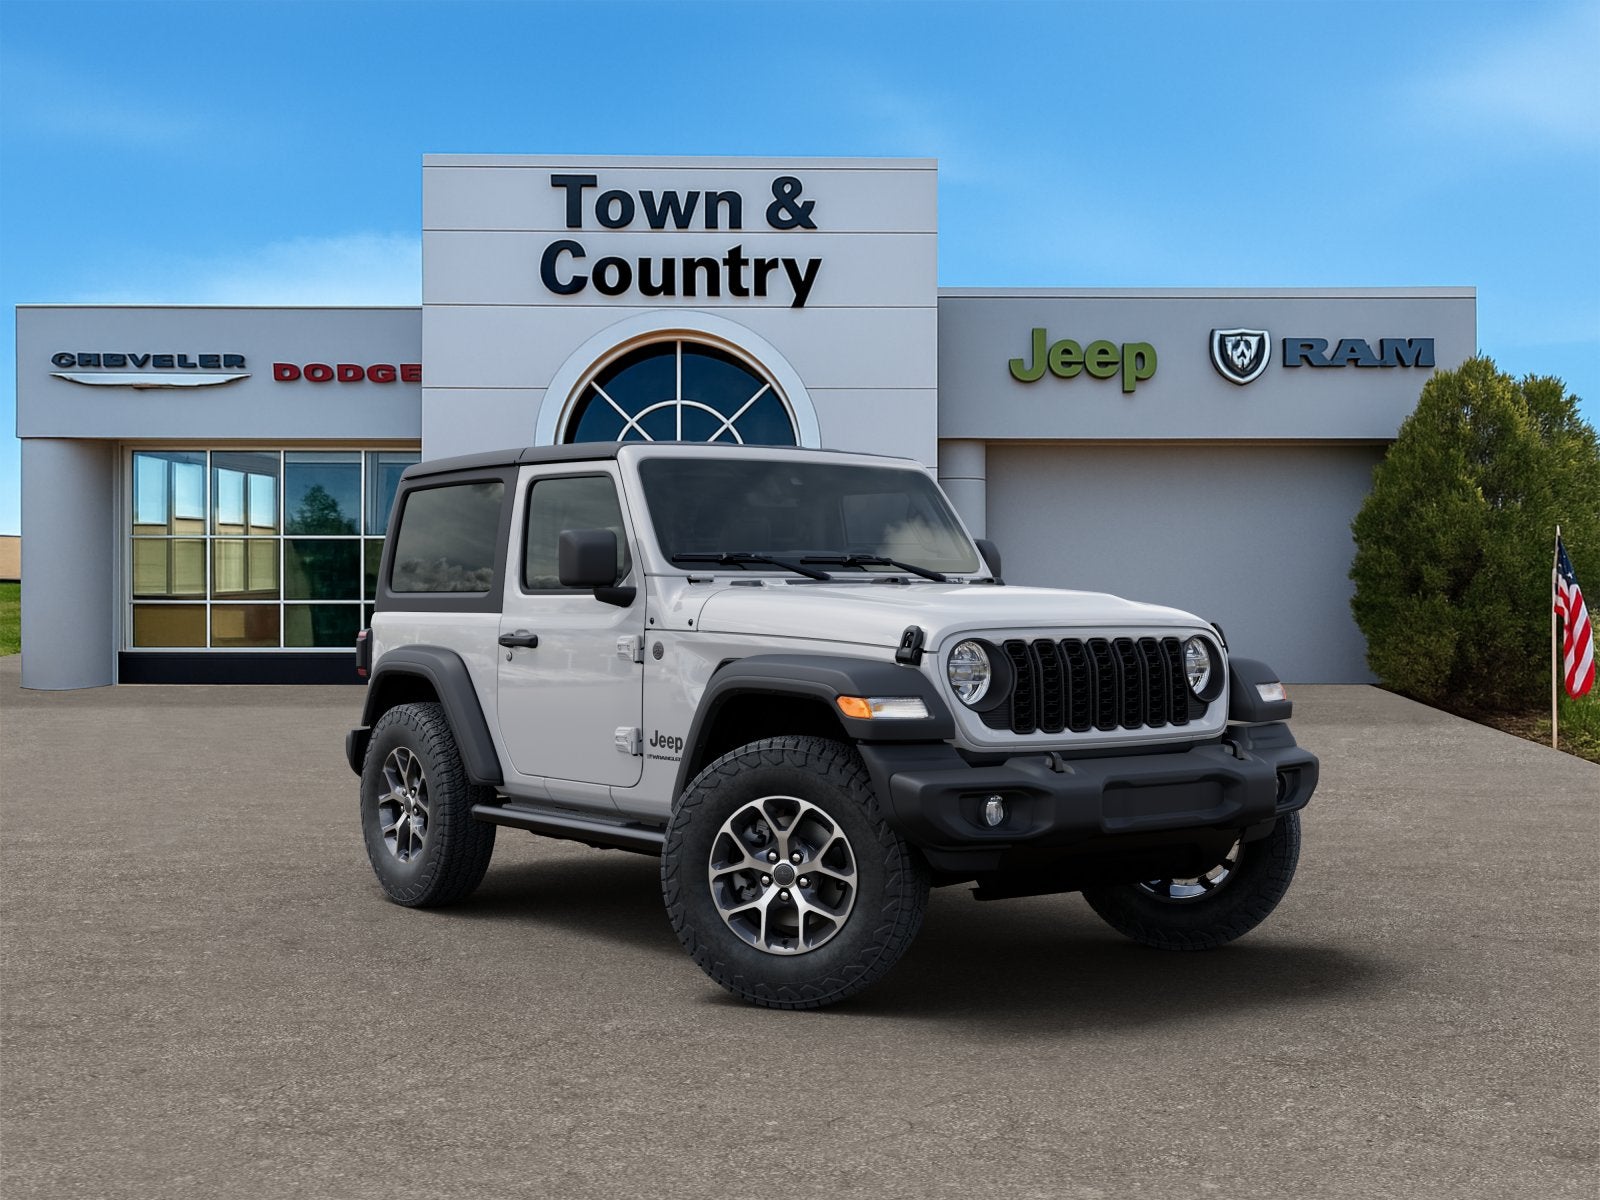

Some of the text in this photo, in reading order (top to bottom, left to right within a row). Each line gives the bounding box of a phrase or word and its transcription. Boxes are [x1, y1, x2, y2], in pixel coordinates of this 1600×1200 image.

[551, 174, 817, 229] Town &
[540, 240, 822, 308] Country
[273, 363, 422, 383] DODGE
[1009, 328, 1158, 393] Jeep
[1283, 337, 1435, 368] RAM
[650, 730, 683, 753] Jeep
